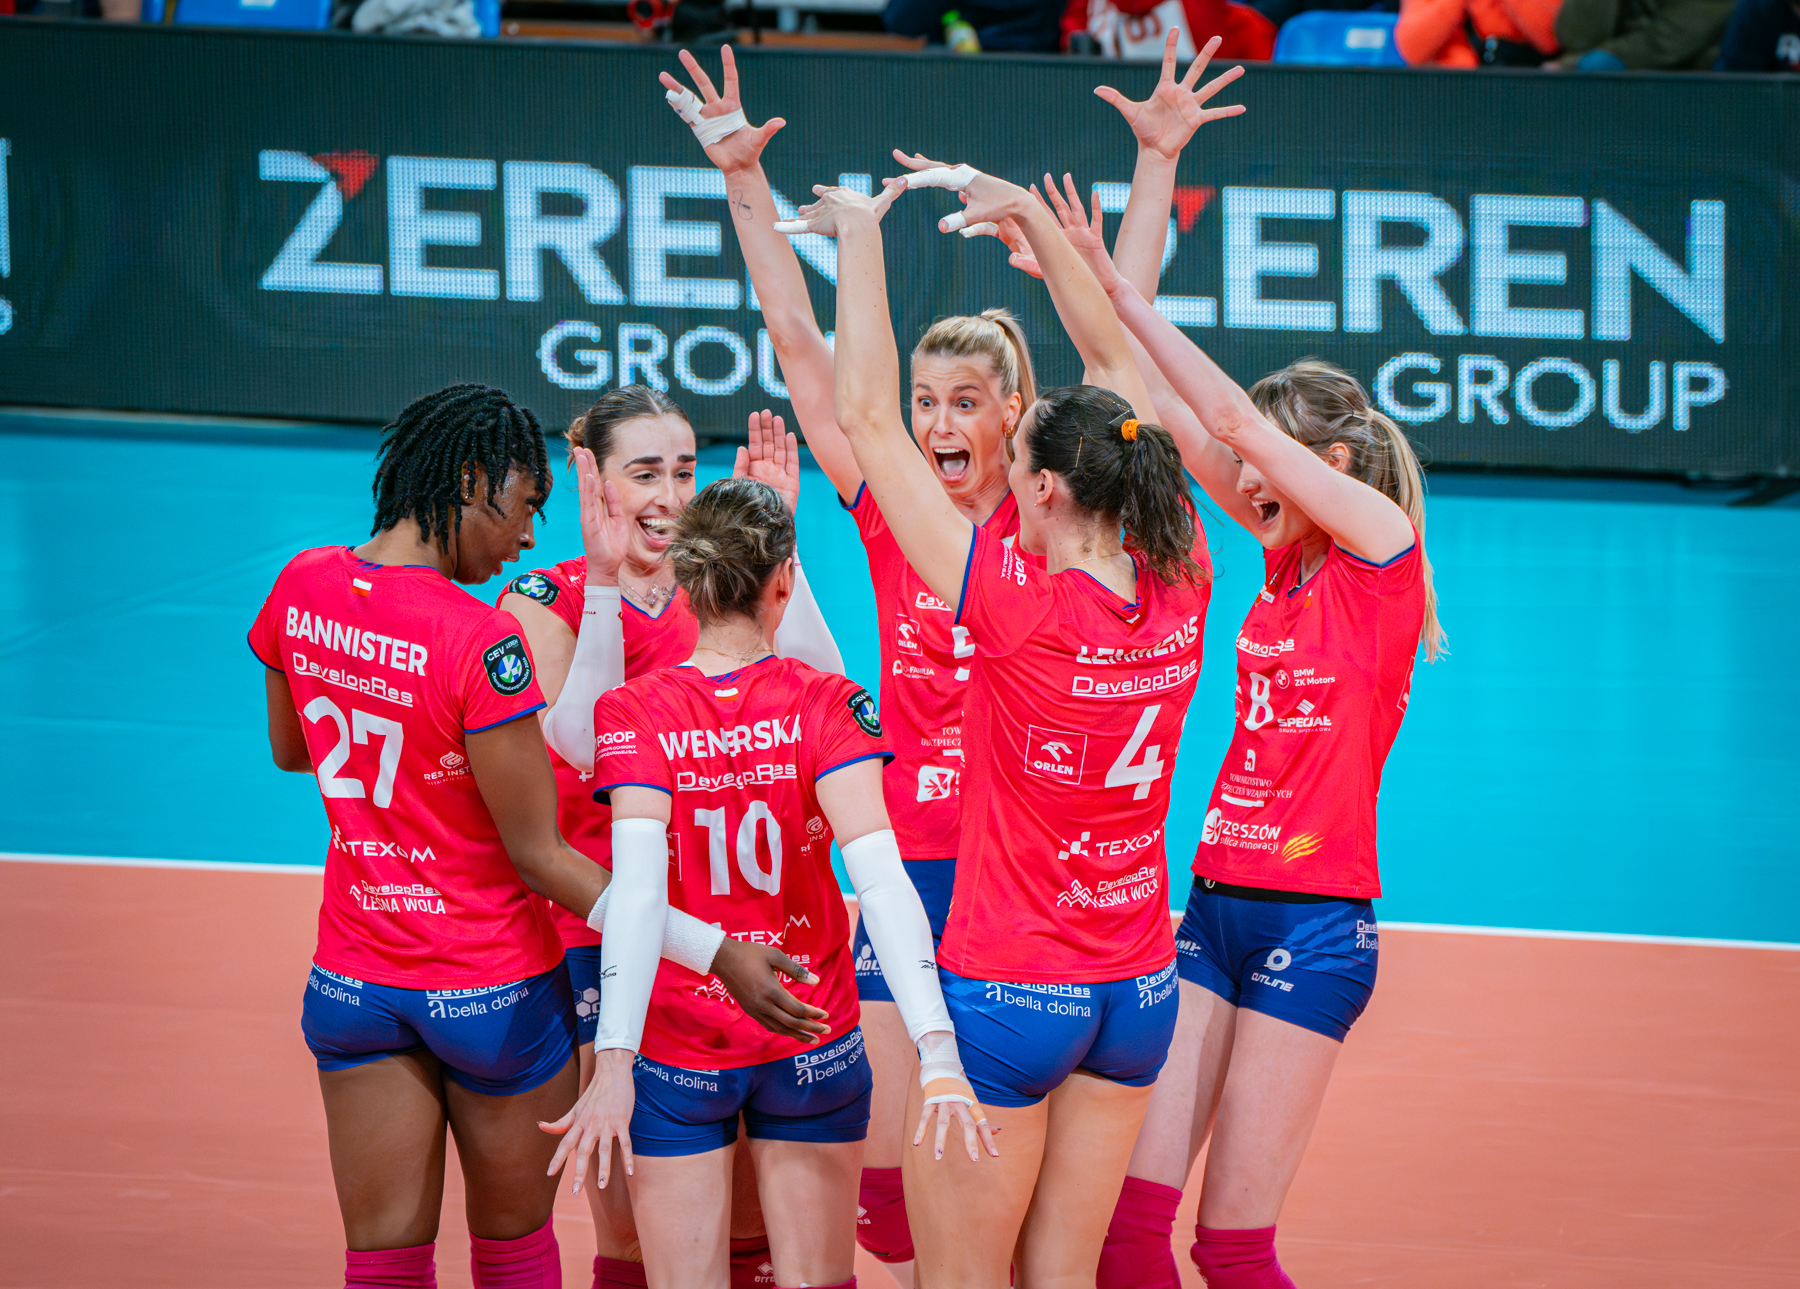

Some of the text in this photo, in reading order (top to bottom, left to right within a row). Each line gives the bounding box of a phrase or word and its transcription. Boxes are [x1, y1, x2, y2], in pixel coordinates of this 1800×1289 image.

[537, 320, 835, 399] GRO
[1374, 352, 1728, 431] GROUP
[286, 606, 428, 676] BANNISTER
[487, 646, 505, 662] CEV
[293, 652, 413, 708] DevelopRes
[1071, 659, 1197, 697] DevelopRes
[1293, 668, 1314, 677] BMW
[1294, 677, 1335, 687] ZK Motors
[303, 696, 404, 808] 27
[1105, 704, 1164, 800] 4
[423, 770, 444, 780] RES
[677, 764, 797, 792] DevepRes
[1034, 760, 1073, 775] ORLEN
[694, 800, 783, 896] 10
[1097, 865, 1158, 892] DevelopRe
[402, 896, 446, 914] WOLA
[731, 914, 811, 946] TEXM
[320, 982, 361, 1006] dolina
[448, 1001, 488, 1018] bella
[491, 986, 529, 1010] dolina
[1004, 990, 1042, 1012] bella
[1046, 1000, 1091, 1017] dolina
[673, 1073, 719, 1092] dolina
[815, 1060, 847, 1081] bella
